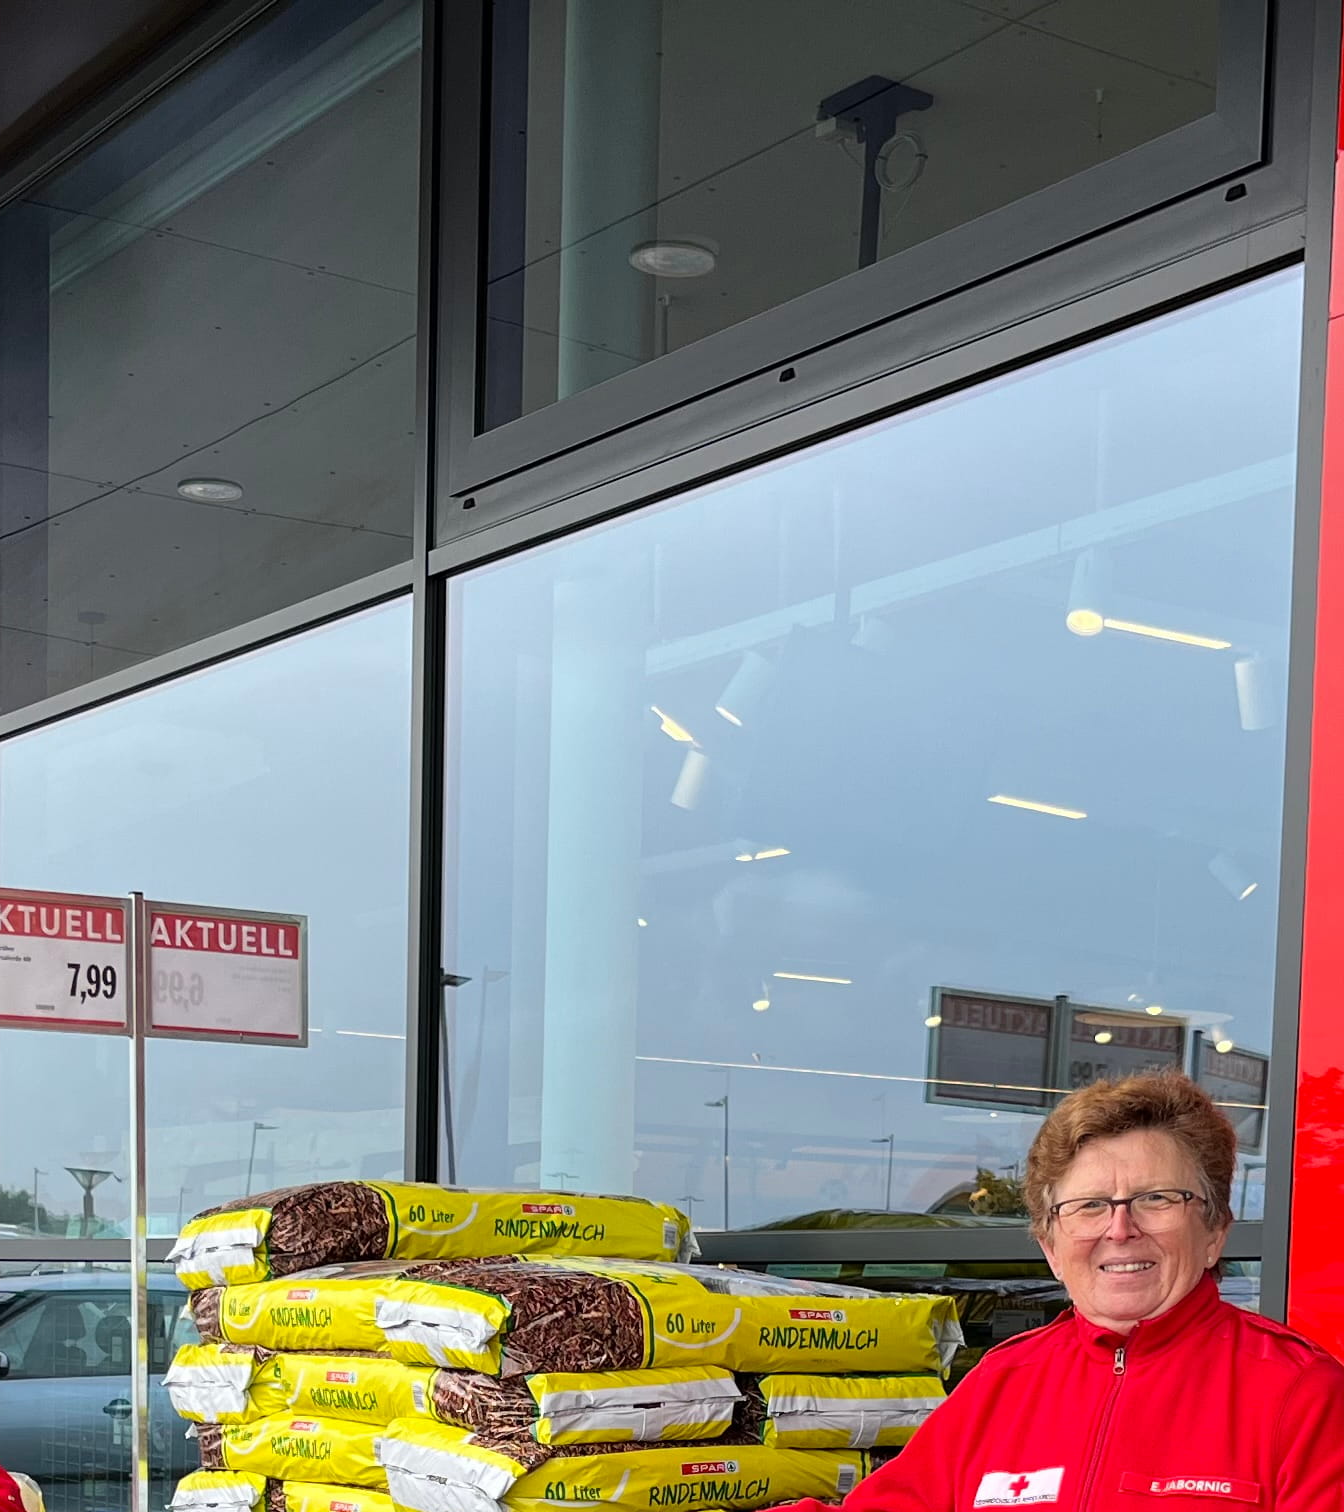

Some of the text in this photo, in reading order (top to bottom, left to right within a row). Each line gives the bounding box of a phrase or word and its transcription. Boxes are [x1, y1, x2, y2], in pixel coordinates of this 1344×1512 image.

[151, 917, 293, 957] AKTUELL
[67, 962, 117, 1005] 7,99
[408, 1204, 455, 1224] 60 Liter
[530, 1205, 562, 1215] SPAR
[494, 1217, 606, 1242] RINDENMULCH
[270, 1307, 333, 1328] RINDENMULCH
[666, 1311, 716, 1335] 60 Liter
[797, 1310, 832, 1320] SPAR
[759, 1326, 879, 1350] RINDENMULCH
[311, 1387, 378, 1411] RINDENMULCH
[271, 1437, 332, 1460] RINDENMULCH
[691, 1463, 726, 1474] SPAR
[545, 1480, 601, 1501] 60 Liter
[649, 1477, 771, 1507] RINDENMULCH
